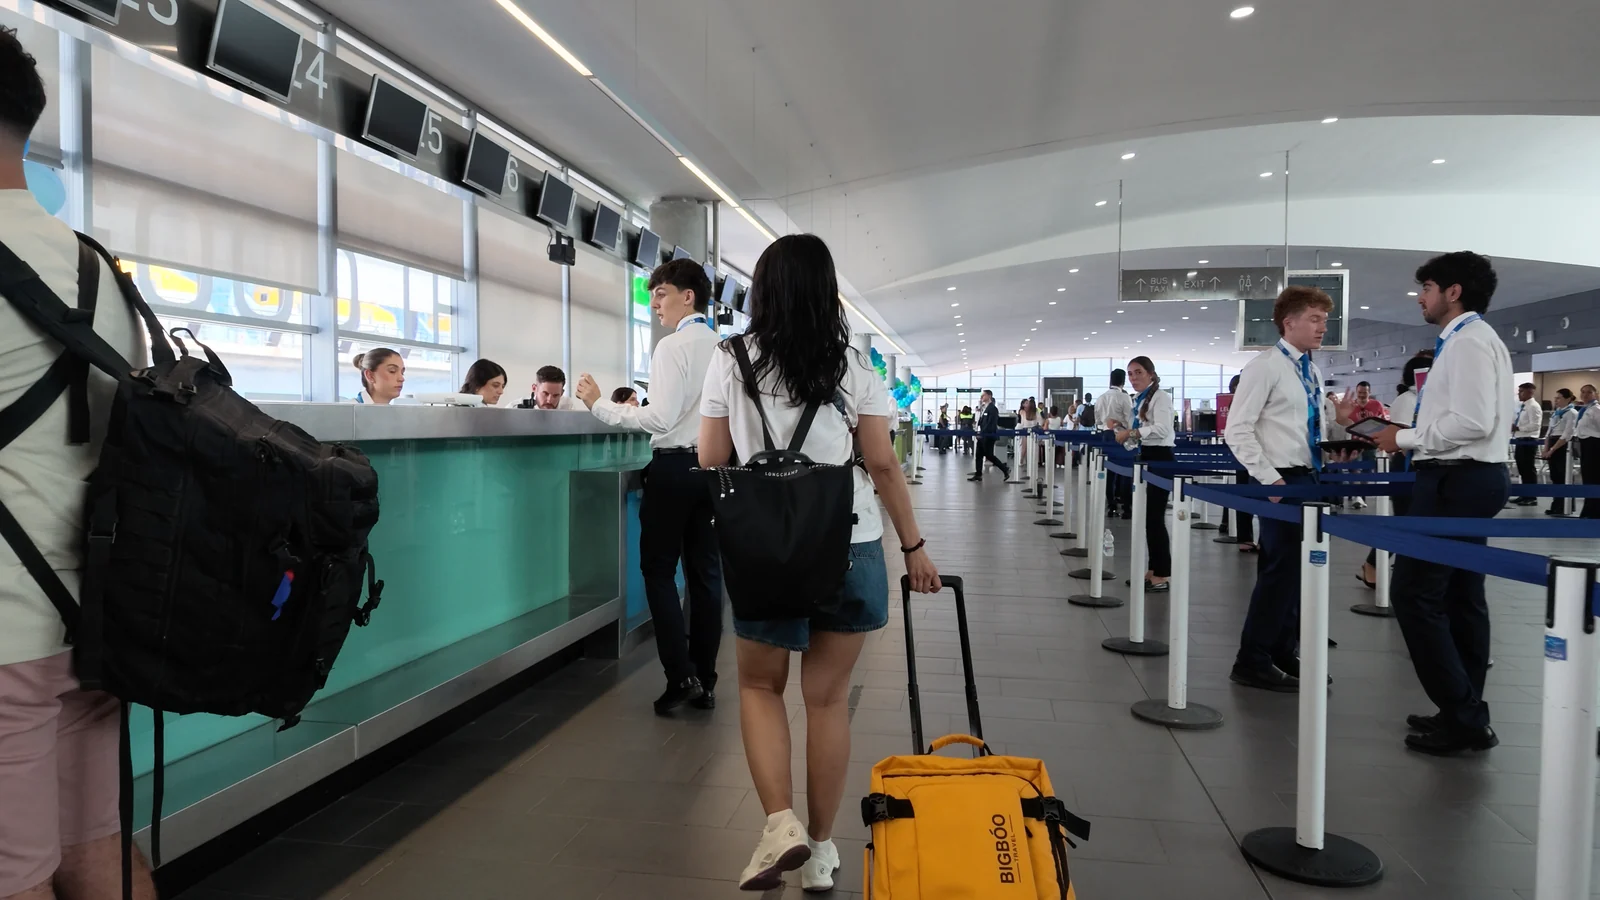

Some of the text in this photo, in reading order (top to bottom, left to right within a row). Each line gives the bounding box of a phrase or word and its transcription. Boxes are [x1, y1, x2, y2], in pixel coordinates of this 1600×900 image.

[1150, 277, 1168, 285] BUS
[1184, 280, 1206, 289] EXIT
[1150, 285, 1169, 293] TAXI
[764, 469, 799, 477] LONGCHAMP
[988, 813, 1015, 884] BIGBÓO
[1010, 833, 1019, 862] TRAVEL
